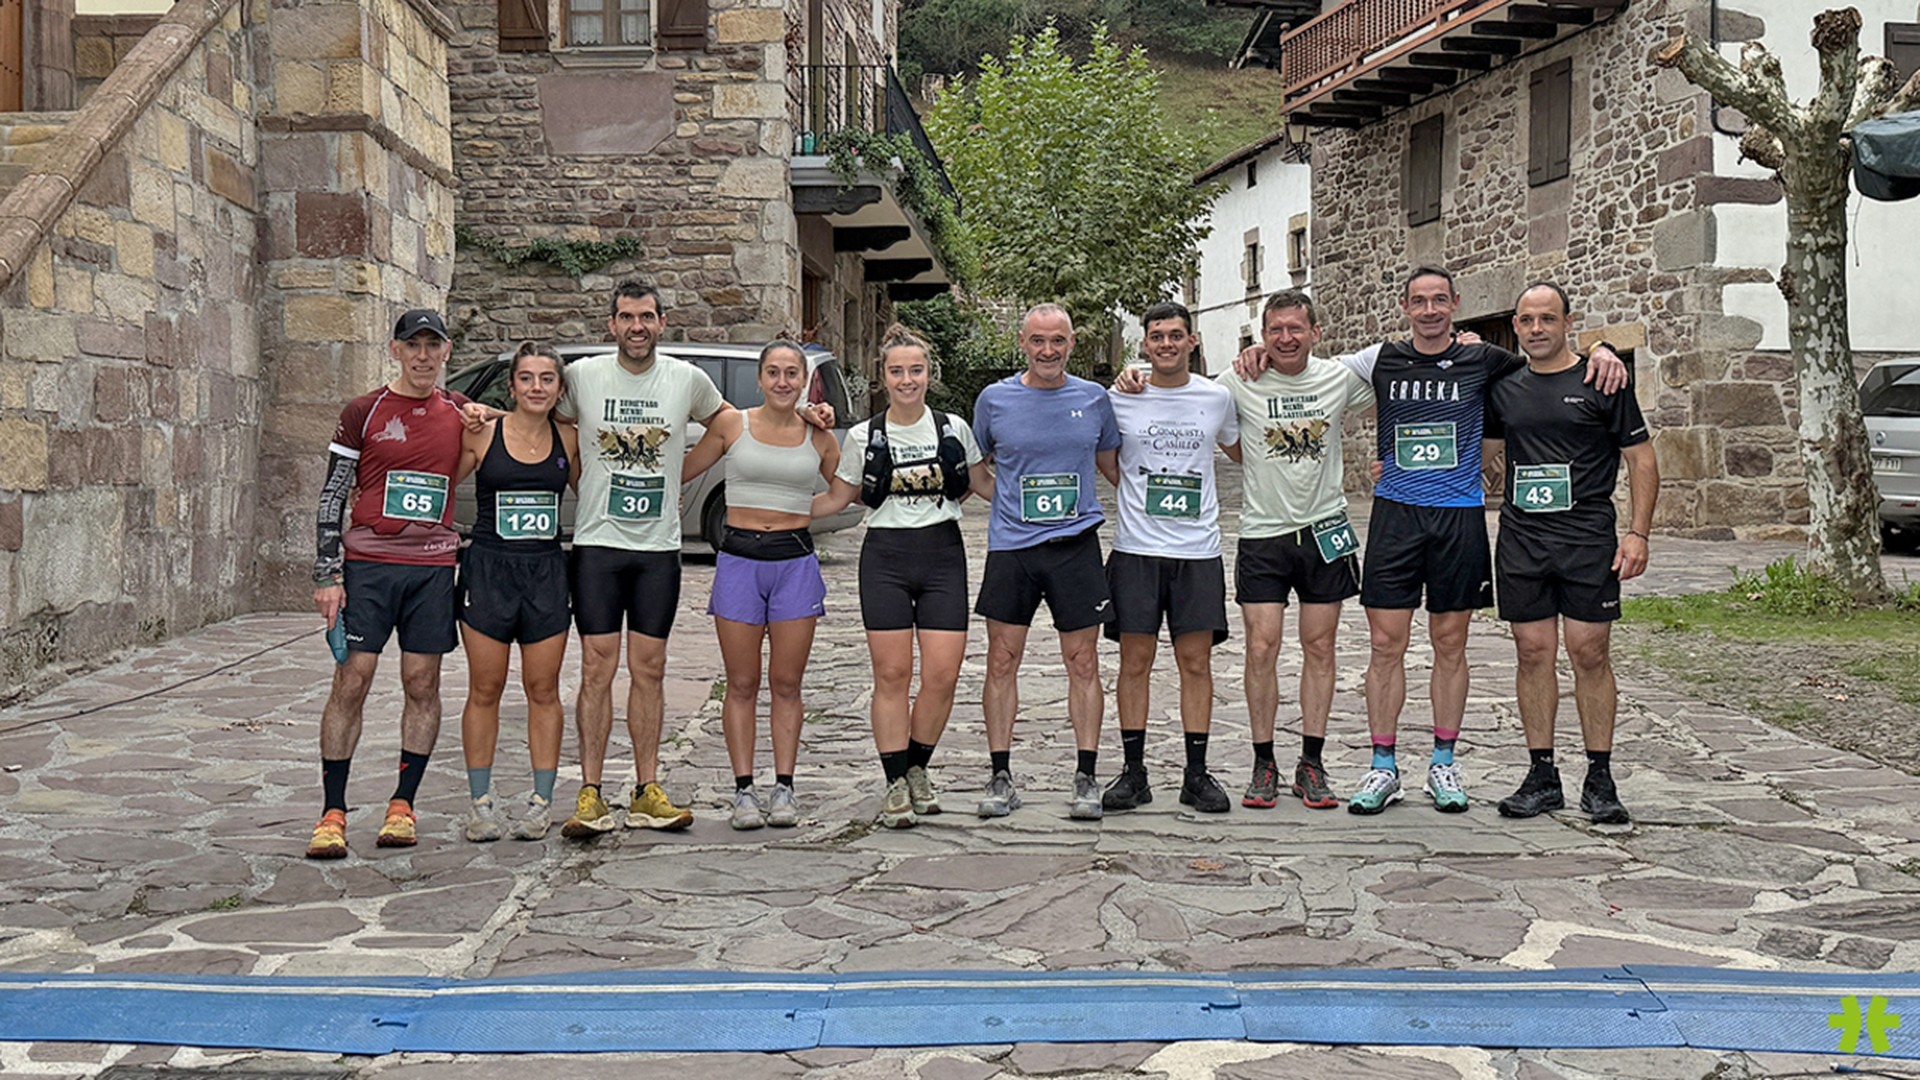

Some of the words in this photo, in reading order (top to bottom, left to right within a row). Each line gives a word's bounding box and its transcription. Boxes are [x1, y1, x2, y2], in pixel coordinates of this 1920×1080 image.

[1389, 380, 1459, 401] ERREKA
[1411, 443, 1440, 461] 29
[402, 492, 432, 512] 65
[1036, 494, 1063, 512] 61
[1159, 493, 1188, 512] 44
[1525, 486, 1554, 504] 43
[621, 496, 650, 513] 30
[507, 513, 550, 531] 120
[1331, 529, 1352, 550] 91
